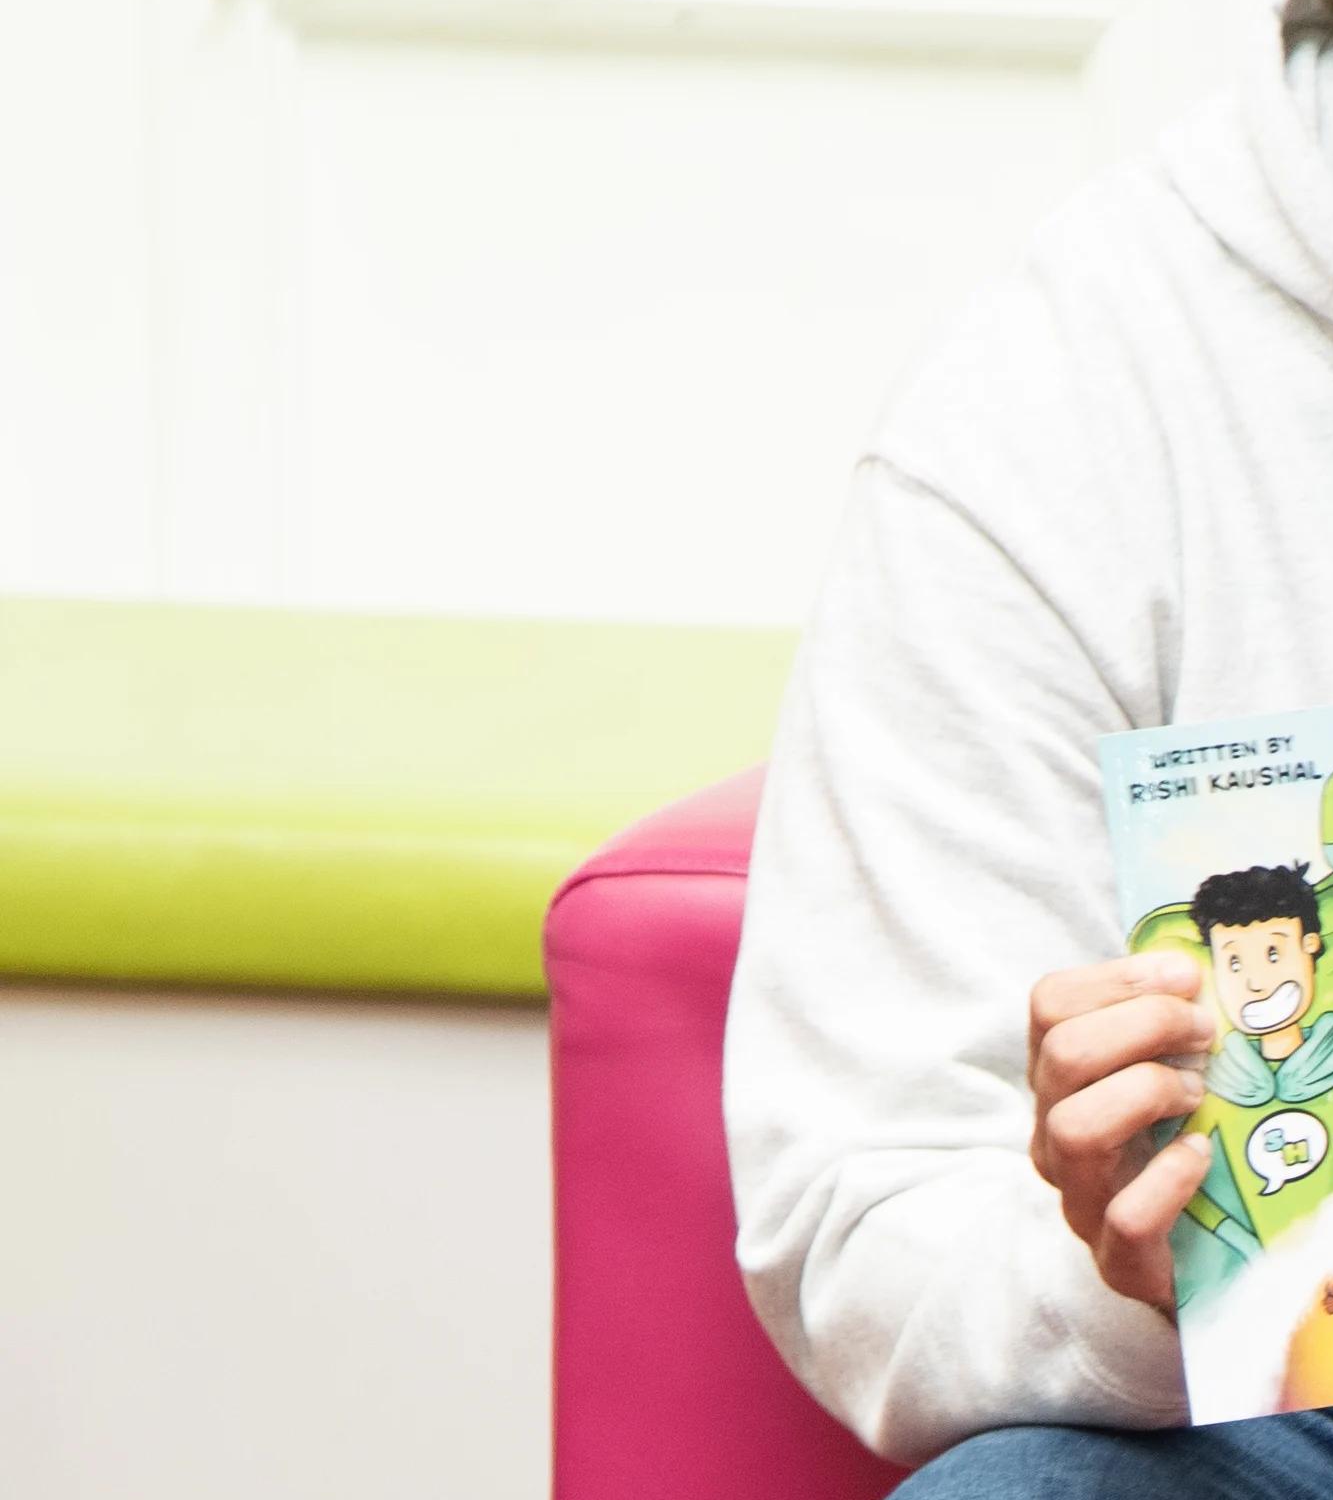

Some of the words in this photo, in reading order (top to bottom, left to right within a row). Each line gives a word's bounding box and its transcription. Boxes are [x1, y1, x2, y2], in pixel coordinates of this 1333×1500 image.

[1149, 739, 1259, 769] WRITTEN
[1266, 733, 1294, 754] BY
[1208, 760, 1323, 793] KAUSHAL
